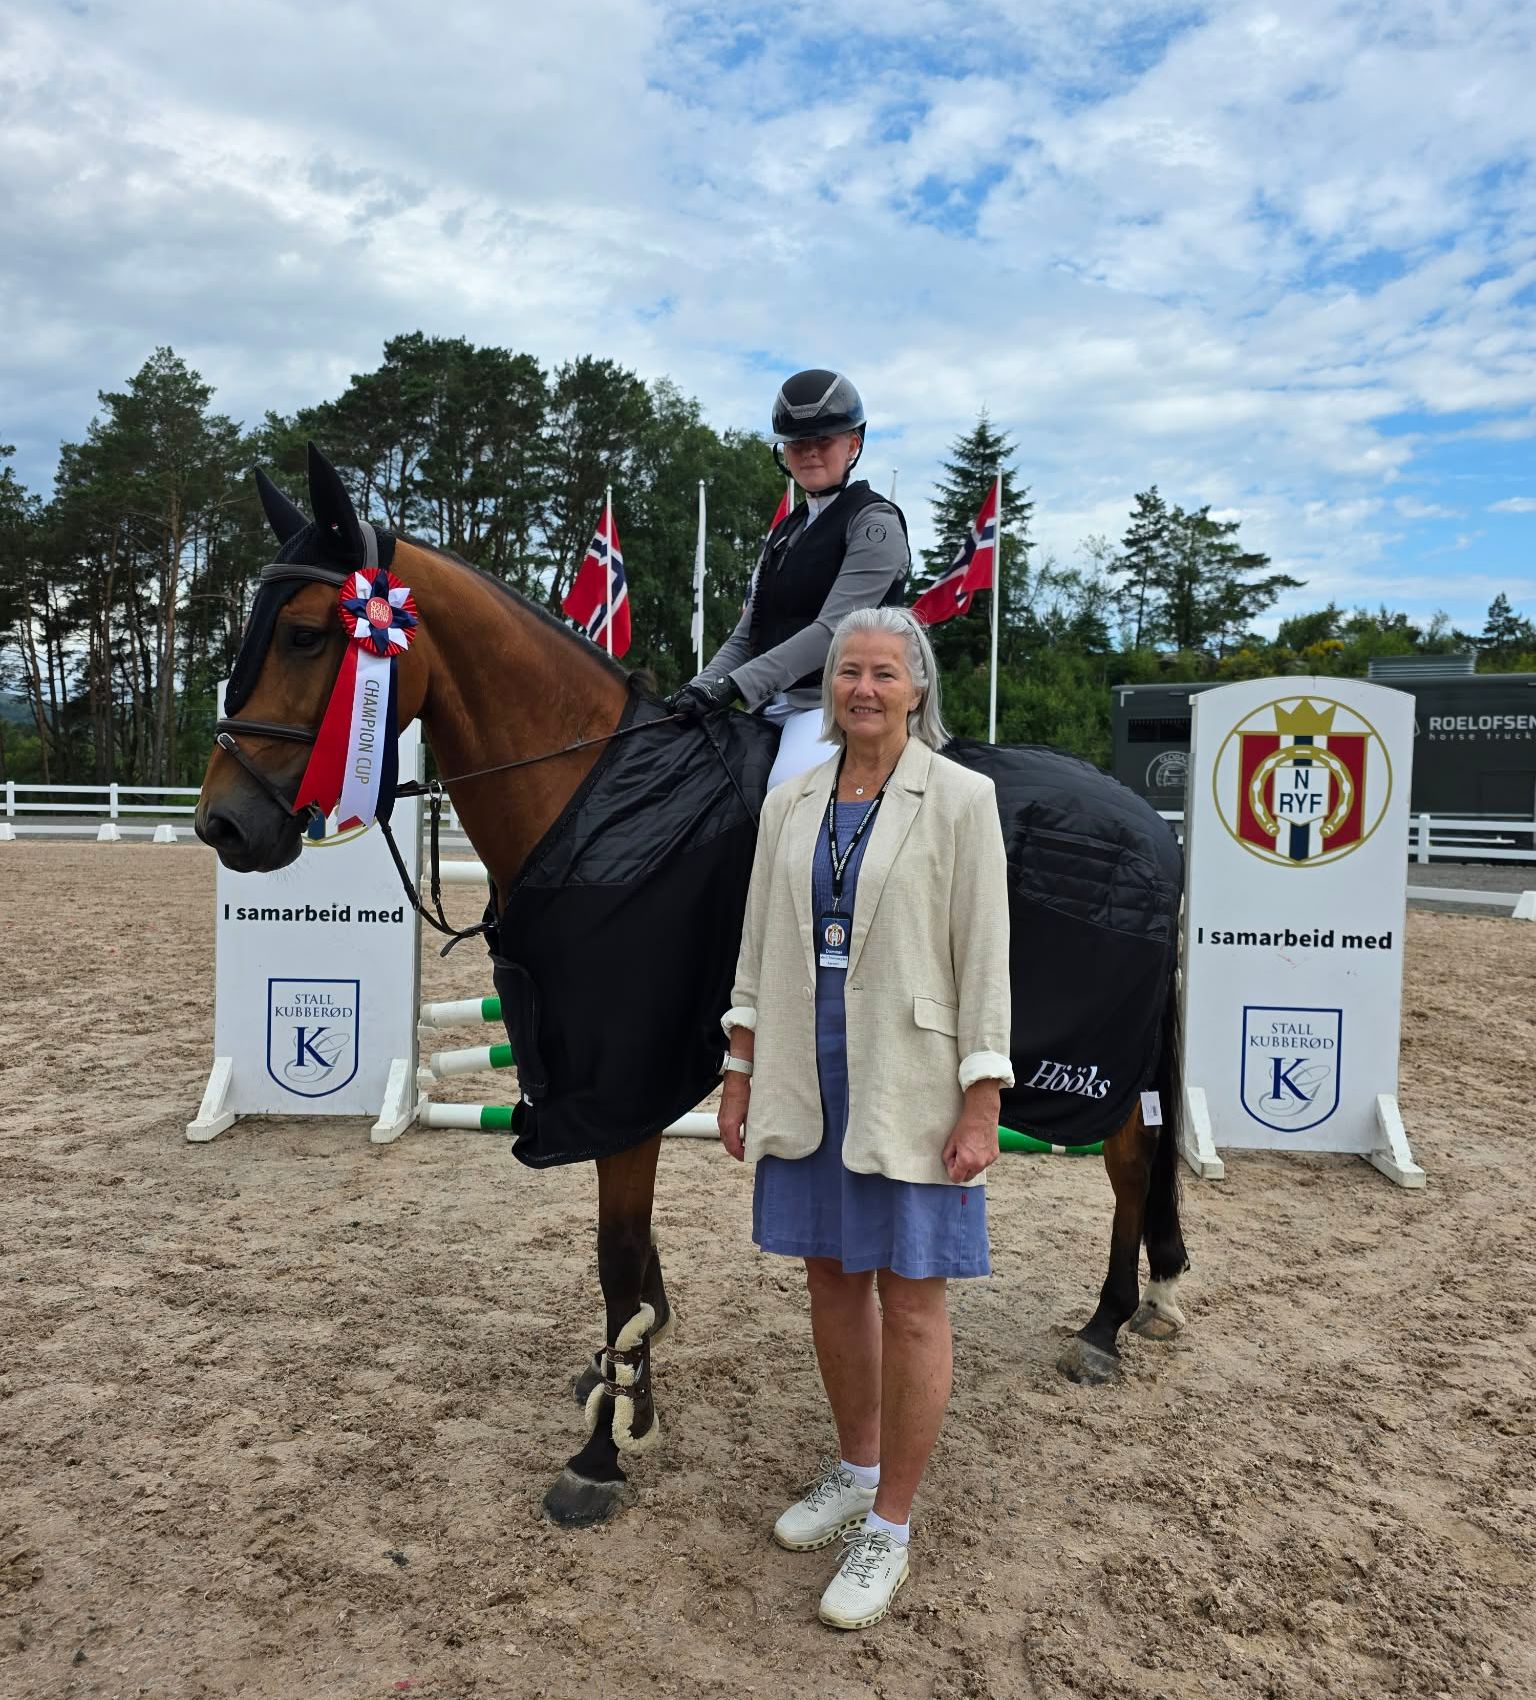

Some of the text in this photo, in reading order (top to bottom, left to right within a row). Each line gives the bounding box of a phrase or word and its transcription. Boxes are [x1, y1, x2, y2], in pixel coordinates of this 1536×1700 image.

[370, 601, 390, 611] OSLO
[1429, 715, 1536, 731] ROELOFSEN
[354, 679, 380, 785] CHAMPION CUP
[1428, 732, 1476, 741] horse
[1294, 769, 1309, 790] N
[1279, 792, 1323, 814] RYF
[224, 903, 404, 924] I samarbeid med
[1197, 927, 1393, 950] I samarbeid med
[294, 993, 335, 1005] STALL
[275, 1006, 353, 1018] KUBBERØD
[1271, 1022, 1314, 1036] STALL
[1250, 1035, 1335, 1050] KUBBERØD
[1024, 1060, 1111, 1099] Hööks
